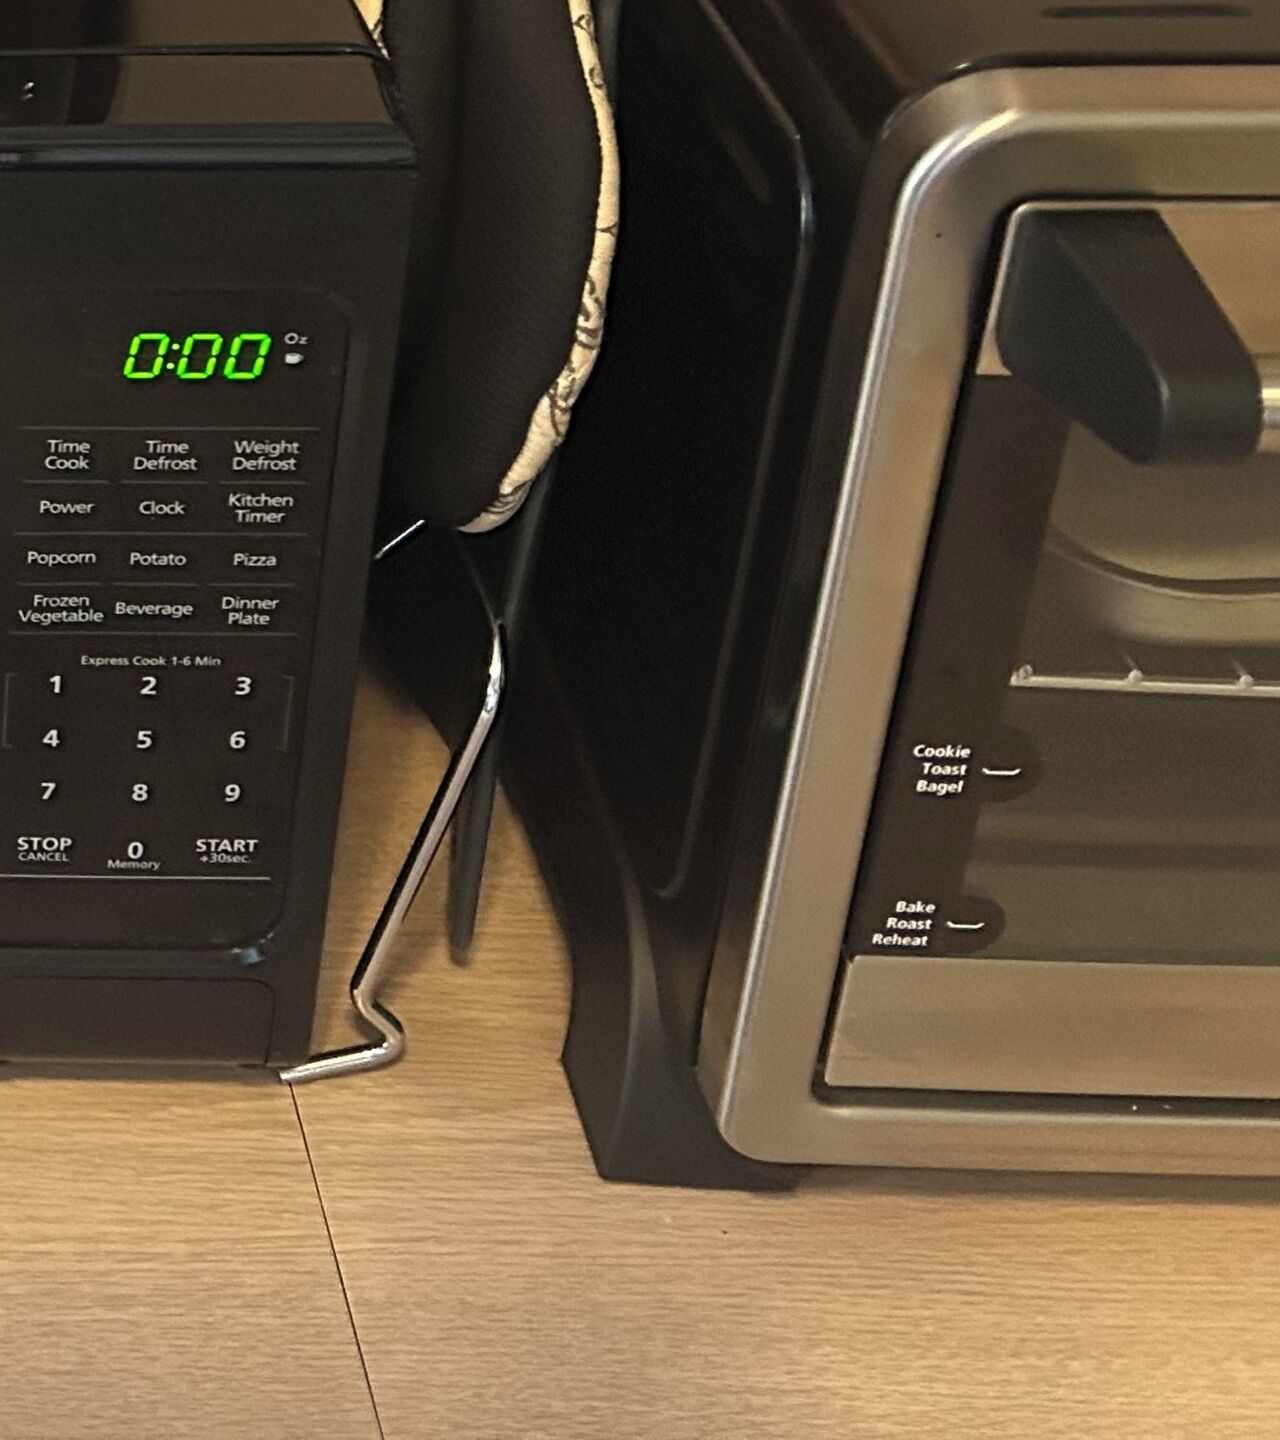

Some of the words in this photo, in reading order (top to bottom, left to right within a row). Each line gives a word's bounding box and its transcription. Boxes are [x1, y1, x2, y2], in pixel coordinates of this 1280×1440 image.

[284, 332, 308, 345] Oz
[123, 333, 272, 380] 0:00
[47, 439, 90, 454] Time
[146, 439, 189, 454] Time
[234, 440, 300, 457] Weight
[44, 455, 90, 470] Cook
[133, 456, 197, 471] Defrost
[232, 456, 297, 471] Defrost
[228, 492, 294, 507] Kitchen
[39, 500, 95, 515] Power
[139, 500, 185, 515] Clock
[235, 509, 285, 523] Timer
[27, 550, 96, 567] Popcorn
[130, 552, 187, 566] Potato
[233, 552, 277, 567] Pizza
[33, 594, 90, 608] Frozen
[222, 596, 279, 610] Dinner
[18, 609, 104, 625] Vegetable
[115, 601, 194, 618] Beverage
[228, 612, 270, 625] Plate
[80, 655, 129, 667] Express
[132, 655, 166, 666] Cook
[171, 656, 191, 666] 1-6
[195, 655, 221, 667] Min
[48, 675, 62, 694] 1
[139, 676, 157, 695] 2
[234, 676, 252, 695] 3
[42, 729, 60, 747] 4
[136, 730, 153, 749] 5
[229, 731, 246, 750] 6
[913, 744, 971, 759] Cookie
[922, 762, 967, 776] Toast
[40, 782, 56, 800] 7
[131, 783, 149, 802] 8
[224, 784, 241, 803] 9
[916, 780, 964, 796] Bagel
[17, 836, 72, 851] STOP
[127, 841, 144, 860] 0
[195, 838, 259, 853] START
[18, 851, 70, 862] CANCEL
[107, 860, 160, 871] Memory
[896, 901, 936, 914] Bake
[886, 917, 932, 930] Roast
[872, 933, 928, 946] Reheat
